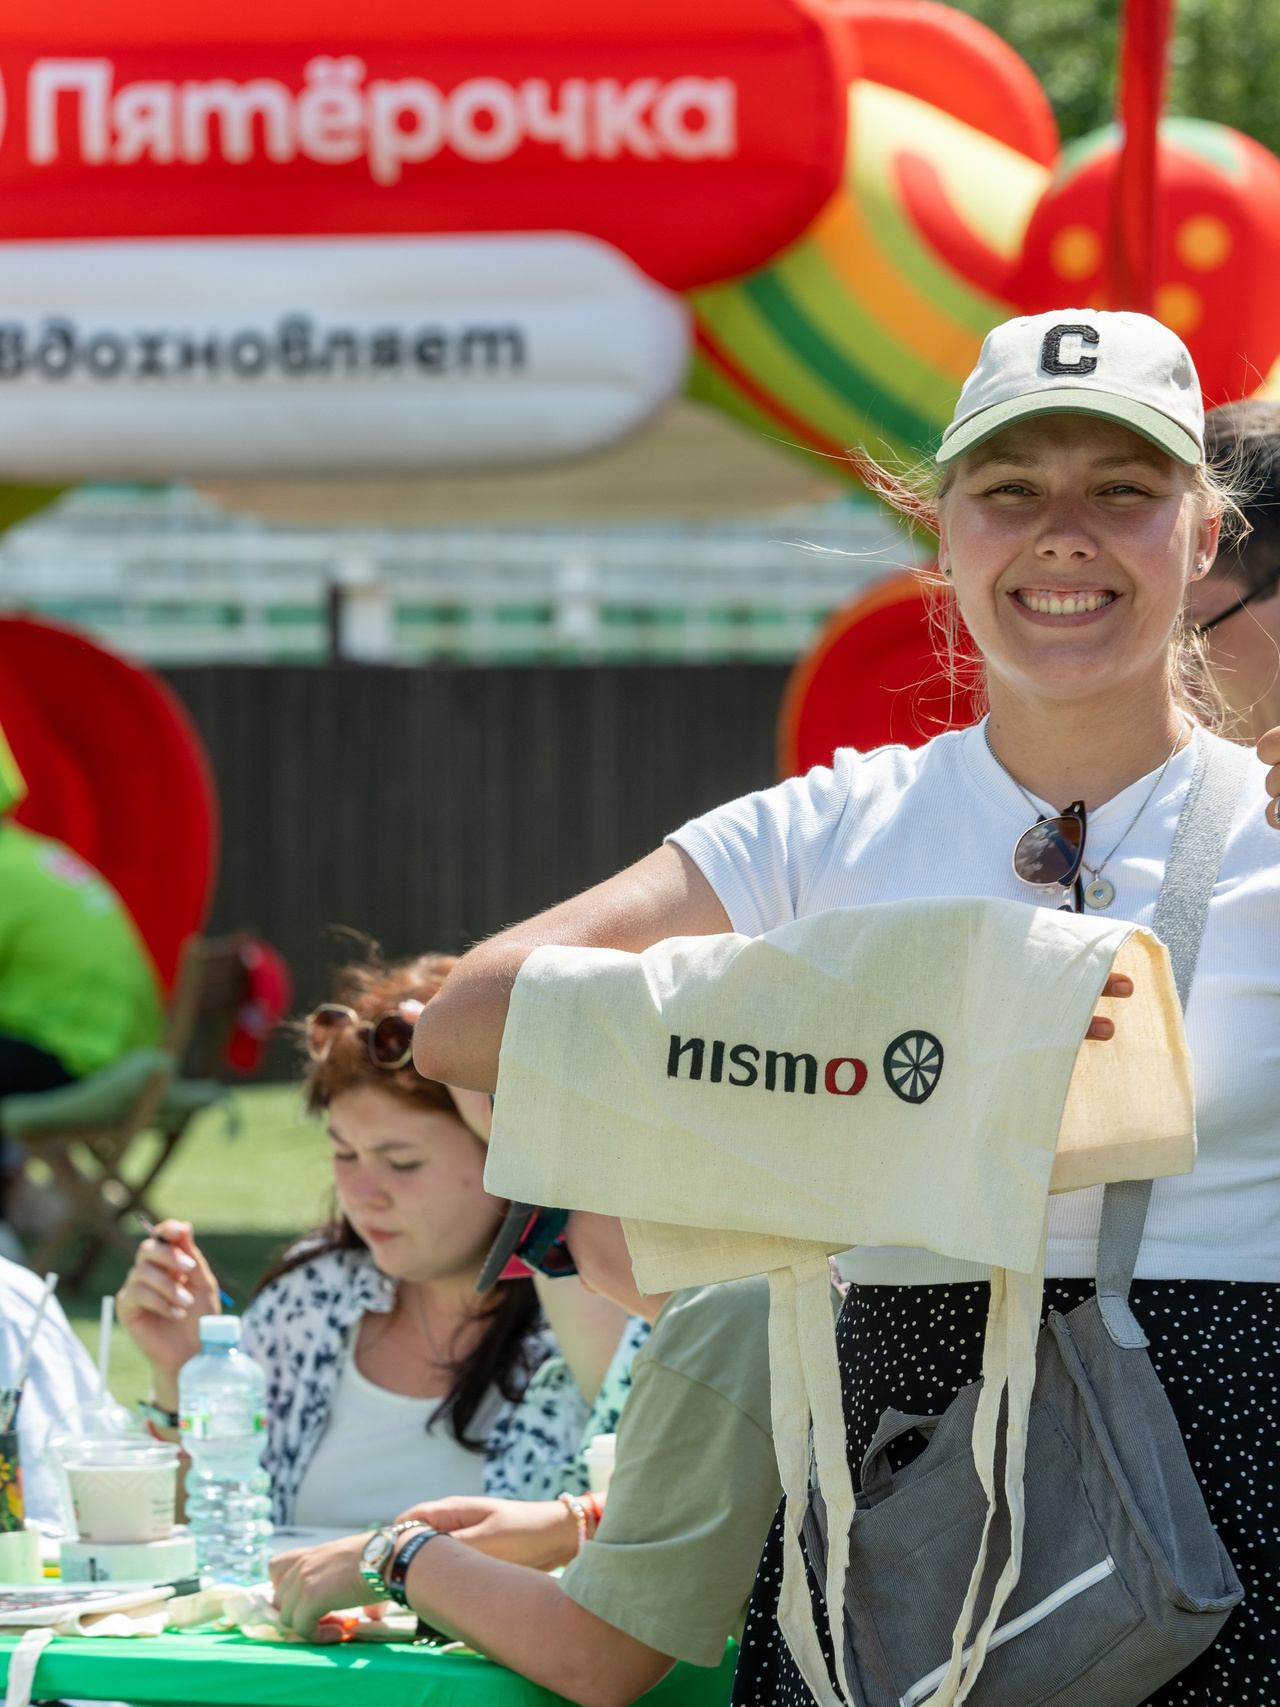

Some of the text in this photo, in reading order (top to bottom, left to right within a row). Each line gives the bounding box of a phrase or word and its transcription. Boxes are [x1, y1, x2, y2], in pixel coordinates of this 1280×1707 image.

[27, 55, 738, 186] Пятёрочка
[1041, 324, 1100, 376] C
[667, 1034, 868, 1096] nismo
